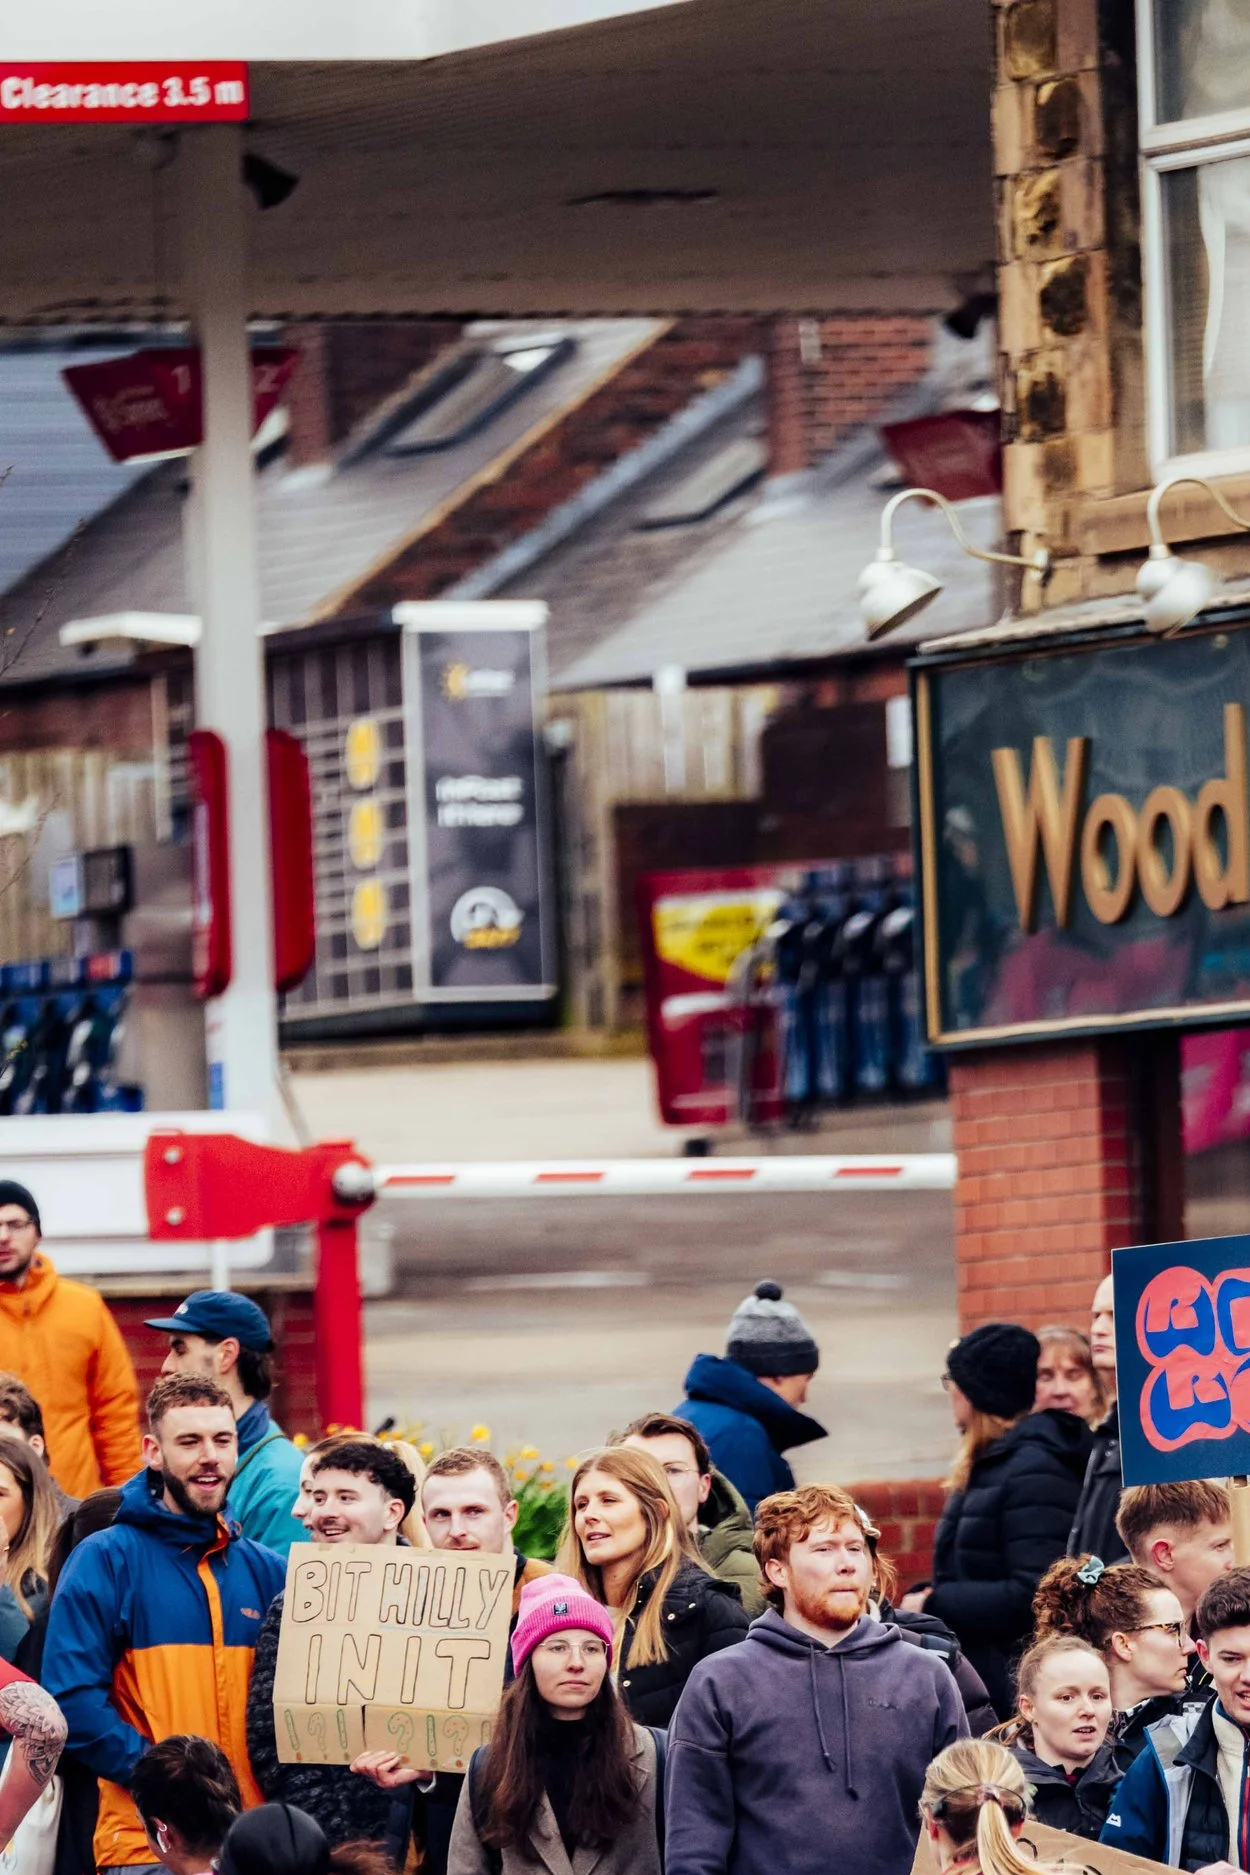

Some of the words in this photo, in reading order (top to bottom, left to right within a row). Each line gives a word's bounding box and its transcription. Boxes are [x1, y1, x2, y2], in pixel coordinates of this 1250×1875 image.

[0, 76, 159, 109] Clearance
[162, 76, 211, 107] 3.5
[214, 80, 244, 105] m
[291, 1560, 373, 1623] BIT
[378, 1562, 510, 1630] HILLY
